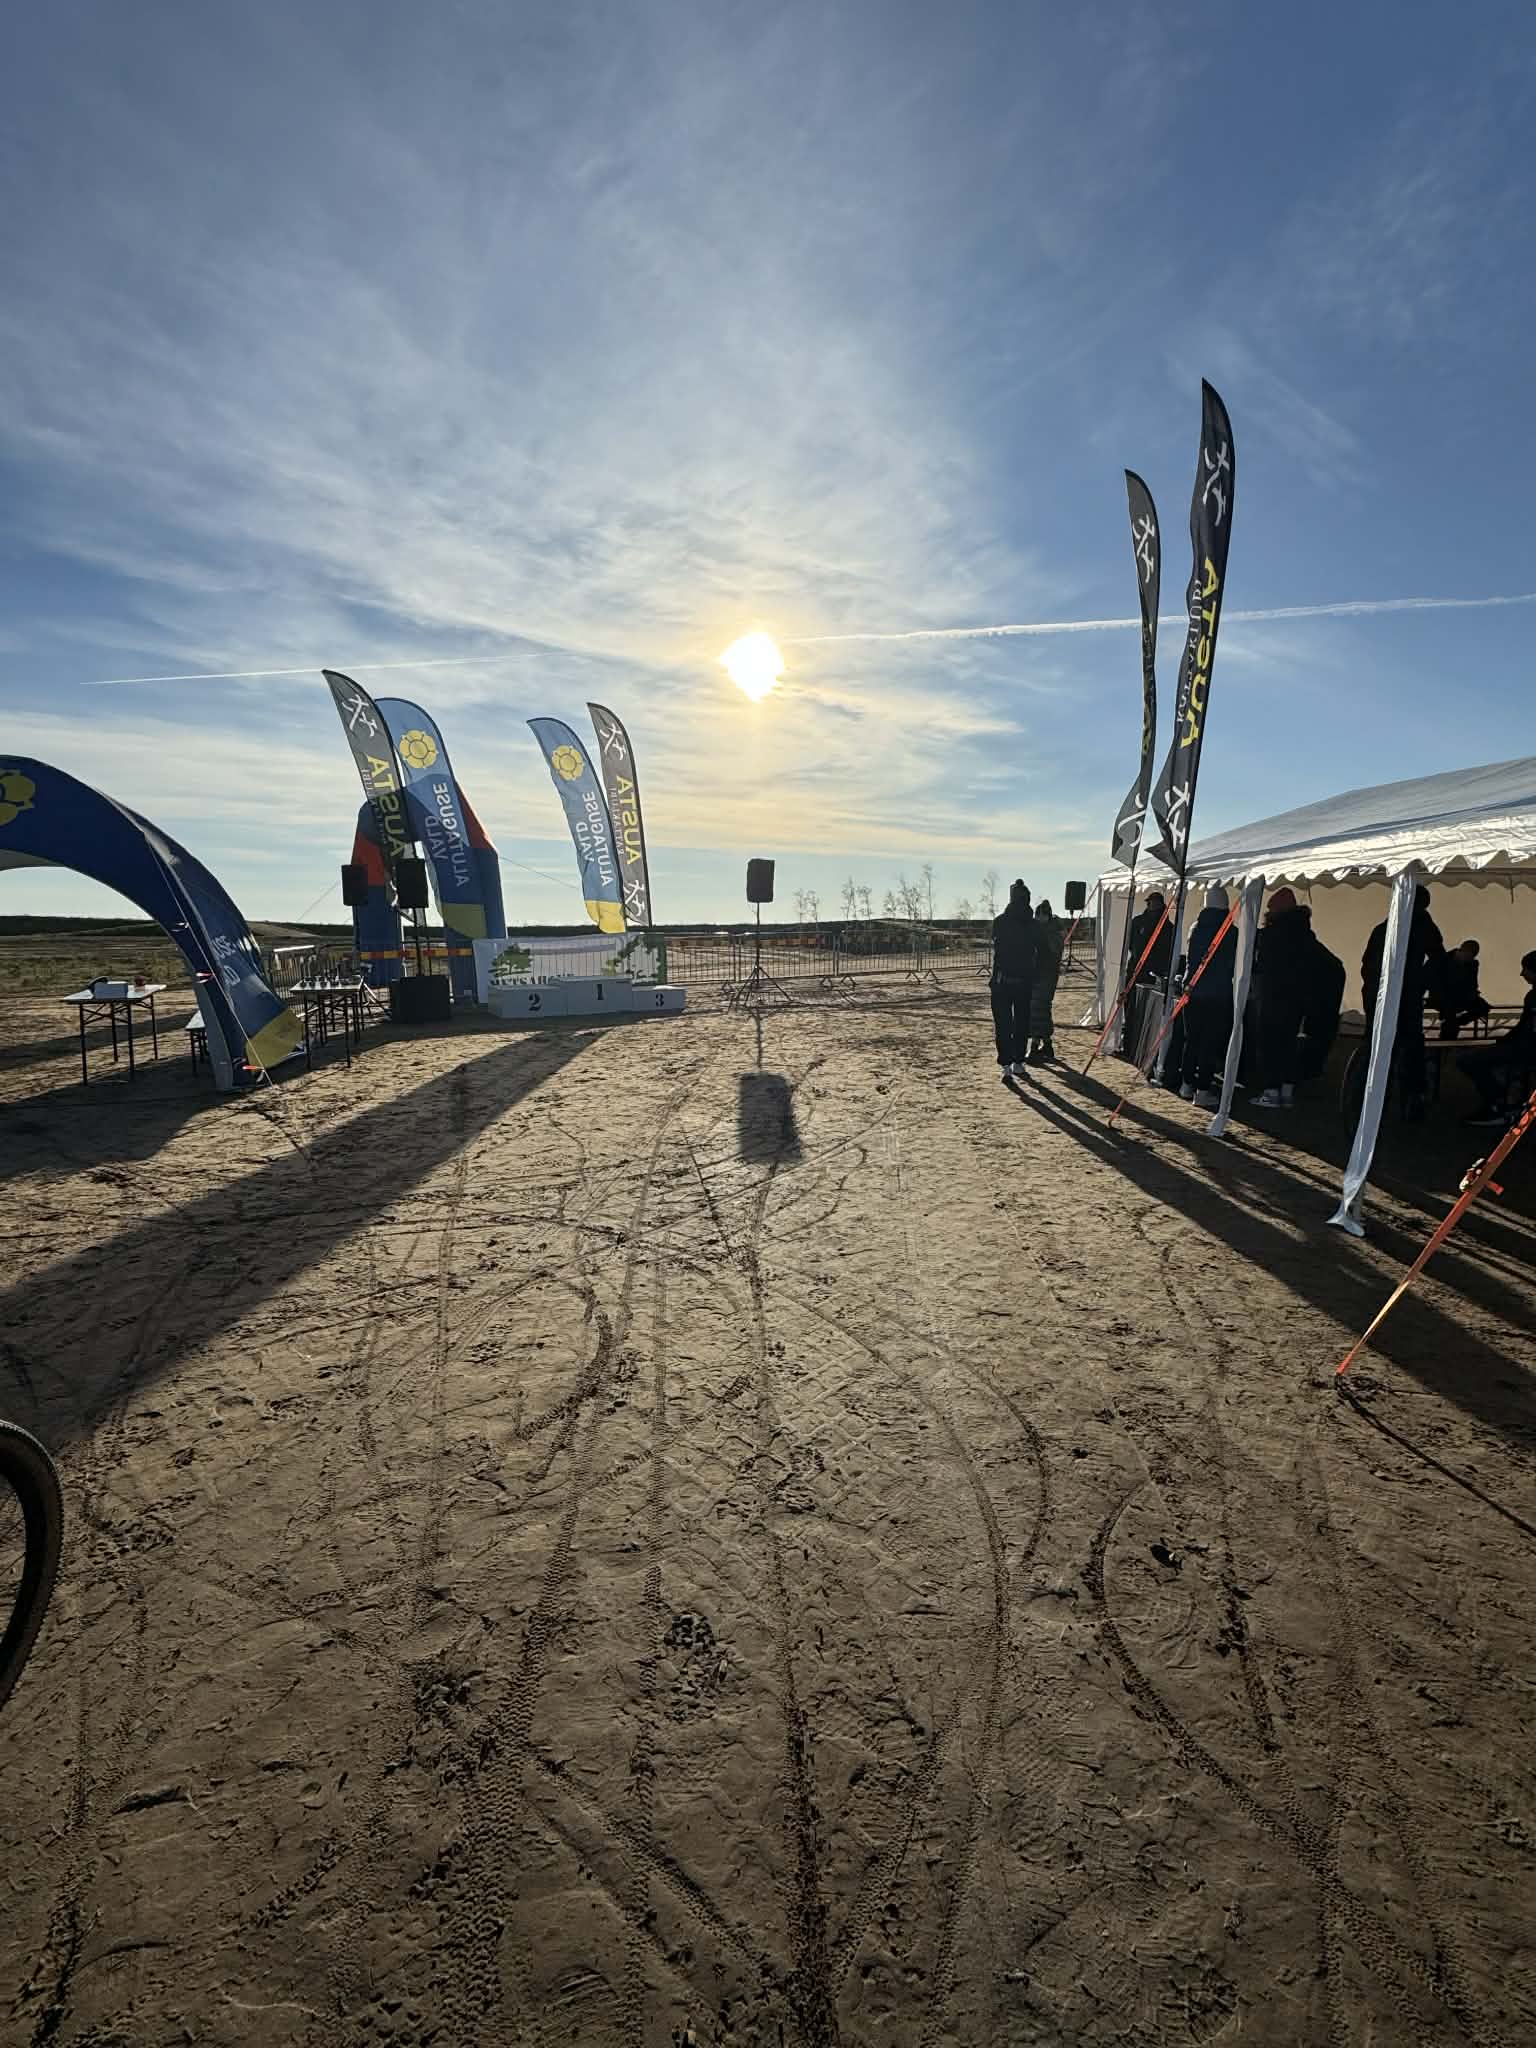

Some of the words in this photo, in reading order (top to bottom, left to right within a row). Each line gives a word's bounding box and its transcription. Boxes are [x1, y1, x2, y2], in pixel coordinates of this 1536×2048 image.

[596, 983, 605, 1001] 1
[655, 992, 665, 1008] 3
[528, 993, 541, 1012] 2
